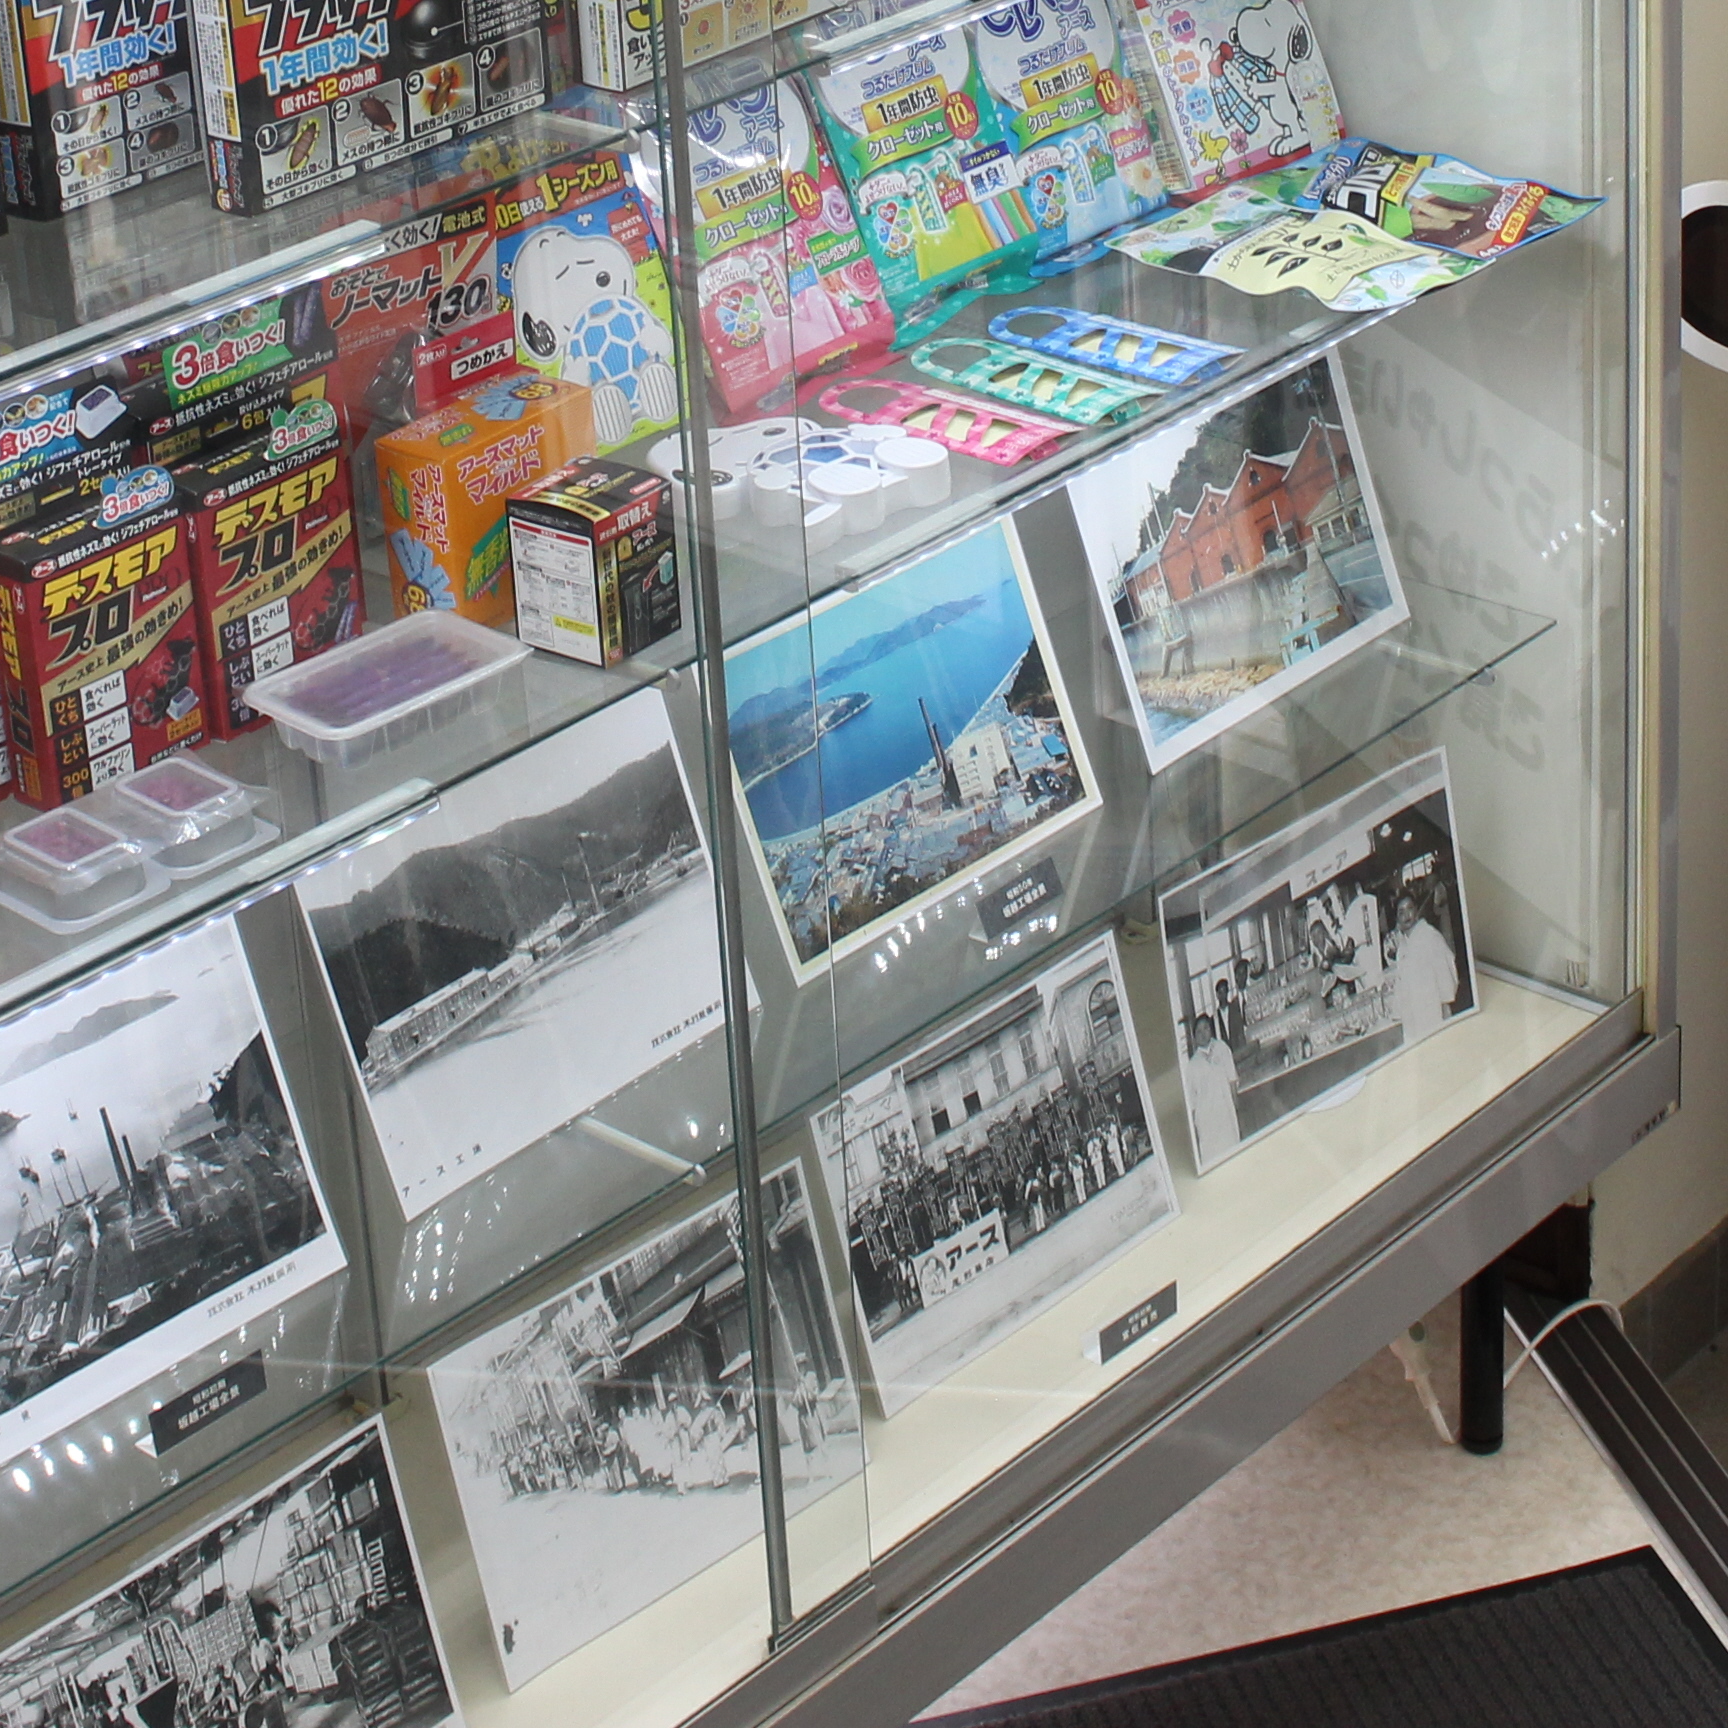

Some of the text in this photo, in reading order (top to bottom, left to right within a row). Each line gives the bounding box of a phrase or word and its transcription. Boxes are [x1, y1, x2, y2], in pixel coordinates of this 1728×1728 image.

[57, 18, 178, 89] 1年間効く!
[260, 16, 393, 95] 1年間効く!
[278, 67, 379, 116] 優れた12の効果
[875, 84, 940, 126] 1年間防虫
[1033, 62, 1091, 101] 1年間防虫
[442, 208, 487, 232] 電池式
[427, 279, 487, 330] 130
[172, 318, 286, 391] 3倍食いつく!
[455, 342, 509, 376] つめかえ
[457, 426, 546, 481] アースマット
[467, 453, 541, 506] マイルド
[213, 457, 340, 547] デスモア
[615, 504, 654, 533] 取替え
[43, 526, 178, 620] デスモア
[218, 512, 299, 592] プロ
[47, 585, 134, 671] プロ
[61, 769, 90, 789] 300
[945, 1223, 1000, 1271] アース
